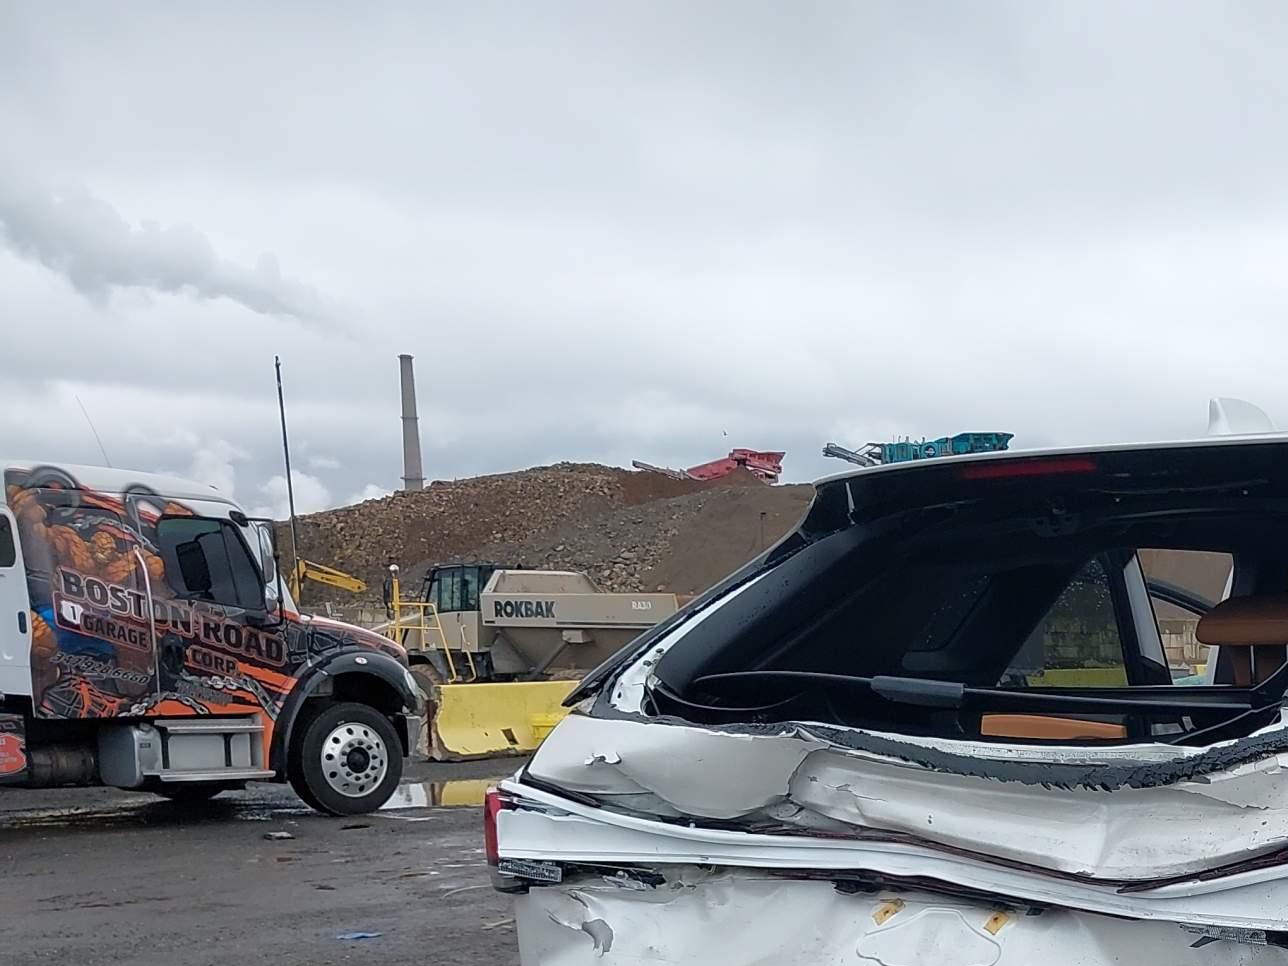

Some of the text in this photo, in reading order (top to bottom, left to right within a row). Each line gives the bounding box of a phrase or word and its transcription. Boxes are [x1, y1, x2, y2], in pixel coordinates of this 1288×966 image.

[60, 569, 286, 665] BOSTON ROAD
[494, 600, 556, 618] ROKBAK
[83, 614, 148, 649] GARAGE
